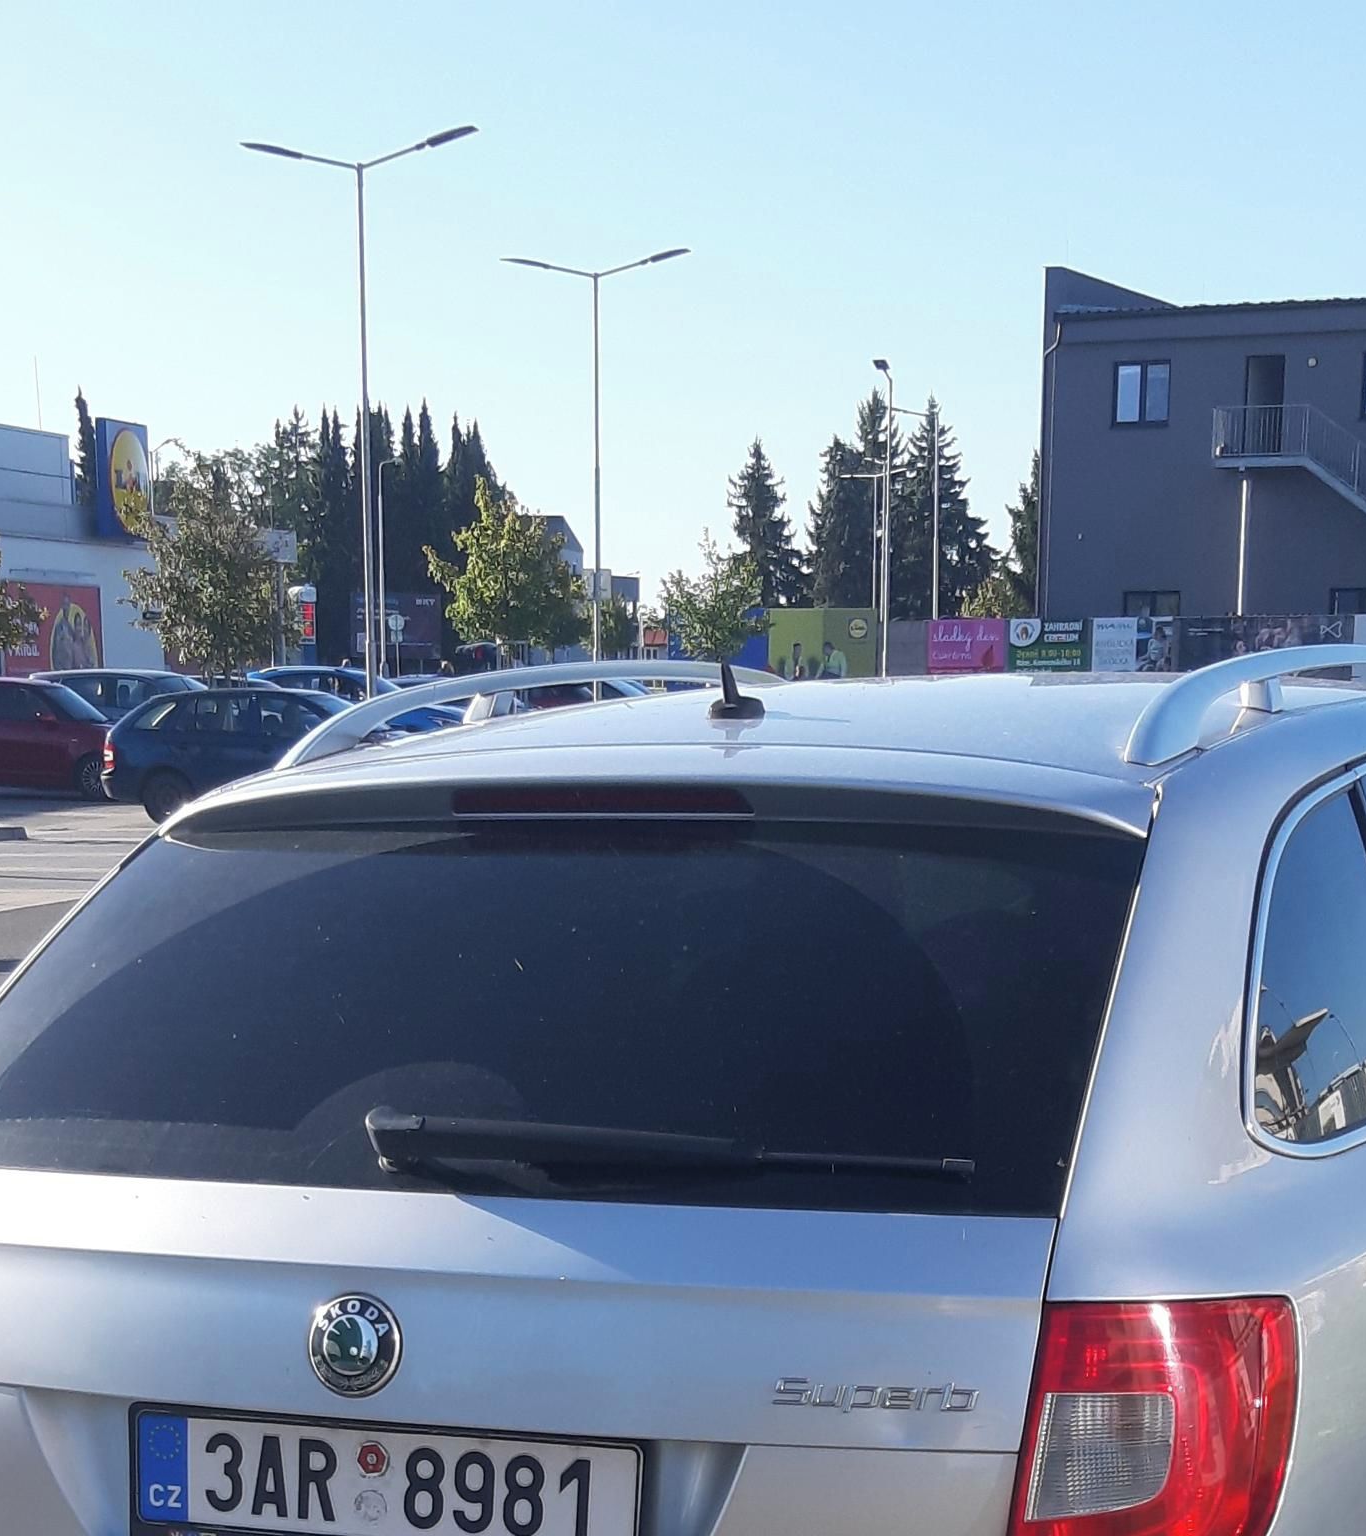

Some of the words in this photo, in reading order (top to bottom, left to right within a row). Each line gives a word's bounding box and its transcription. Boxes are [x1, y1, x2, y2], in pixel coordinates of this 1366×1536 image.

[772, 1377, 980, 1413] Superb
[205, 1432, 337, 1523] 3AR
[148, 1483, 182, 1509] CZ
